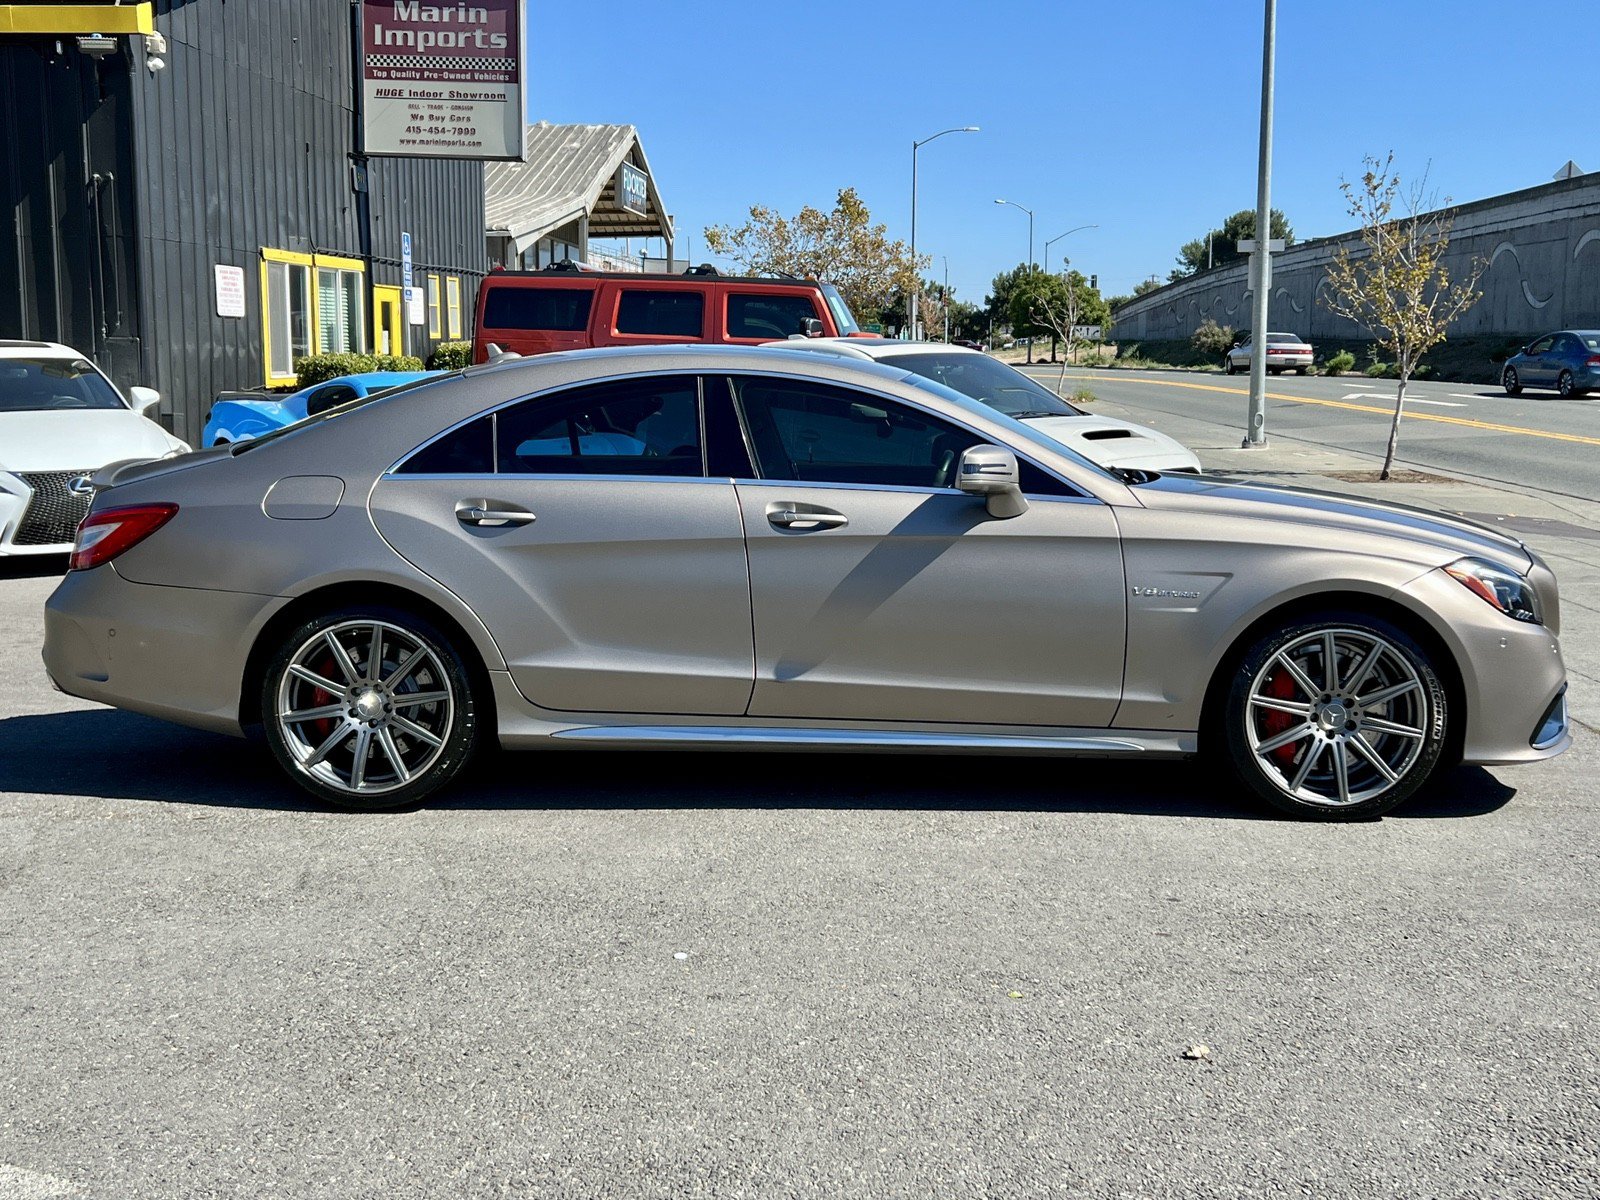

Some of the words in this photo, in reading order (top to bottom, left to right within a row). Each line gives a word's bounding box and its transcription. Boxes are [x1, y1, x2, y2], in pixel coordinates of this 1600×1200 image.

[393, 0, 488, 24] Marin
[374, 23, 508, 53] Imports
[372, 69, 388, 78] Top
[390, 70, 421, 79] Quality
[424, 71, 471, 80] Pre-Owned
[474, 72, 509, 81] Vehicles
[375, 88, 404, 97] HUGE
[408, 89, 443, 98] Indoor
[448, 90, 506, 99] Showroom
[410, 113, 424, 121] We
[428, 114, 446, 123] Buy
[450, 114, 471, 122] Cars
[1428, 677, 1443, 740] MICHELIN
